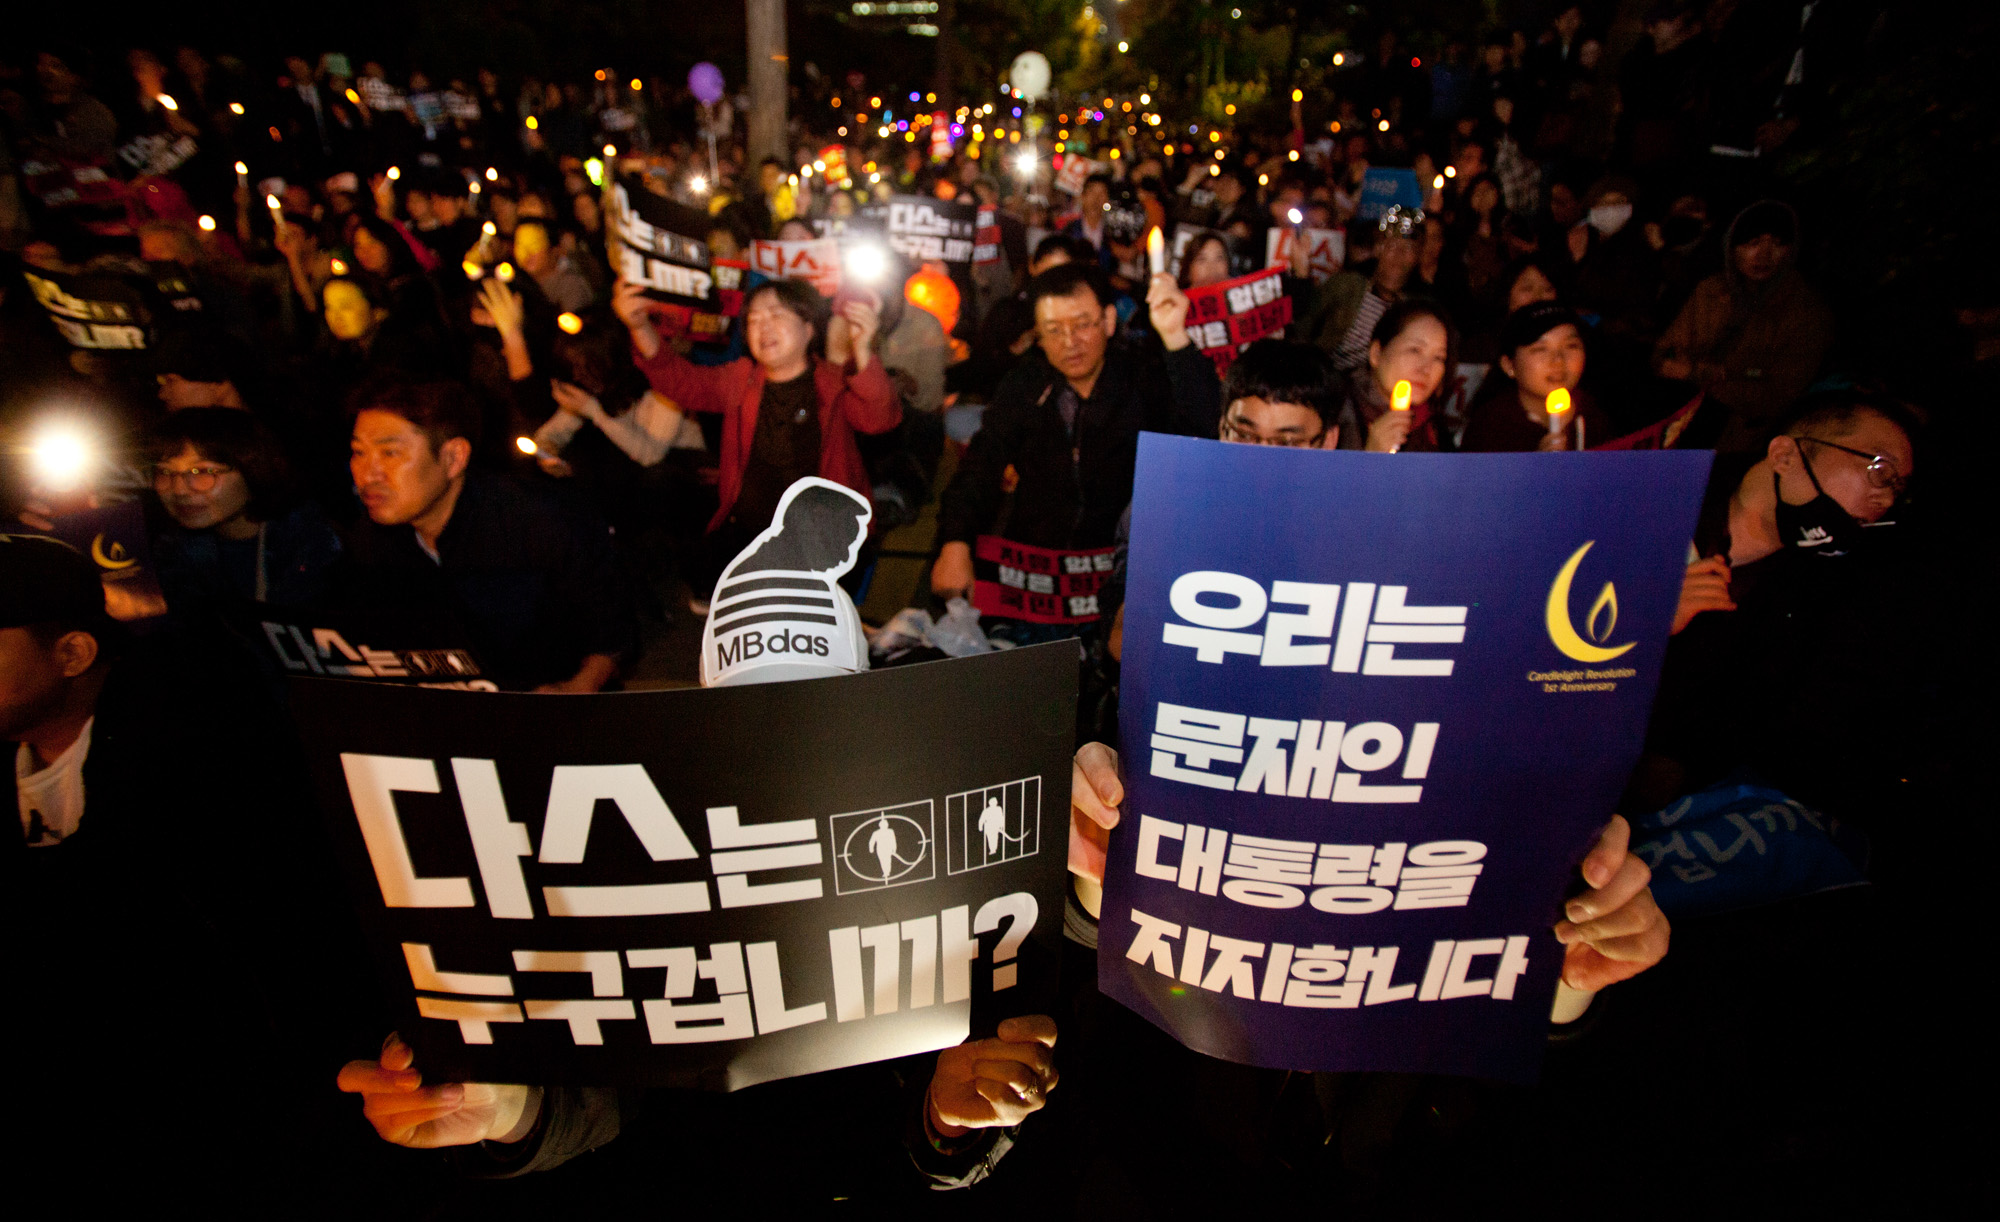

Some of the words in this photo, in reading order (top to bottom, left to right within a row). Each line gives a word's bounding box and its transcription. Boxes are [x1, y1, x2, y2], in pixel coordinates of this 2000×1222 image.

[260, 621, 410, 677] 다스는
[717, 628, 829, 671] MBdas
[1163, 571, 1468, 677] 우리는
[1527, 670, 1584, 682] Candlelight
[1585, 668, 1637, 679] Revolution
[1543, 683, 1558, 693] 1st
[1560, 682, 1617, 692] Anniversary
[1150, 702, 1440, 803] 문재인
[341, 752, 823, 919] 다스는
[1136, 814, 1488, 914] 대통령을
[401, 891, 1039, 1045] 누구겁니까?
[1126, 908, 1530, 1009] 지지합니다
